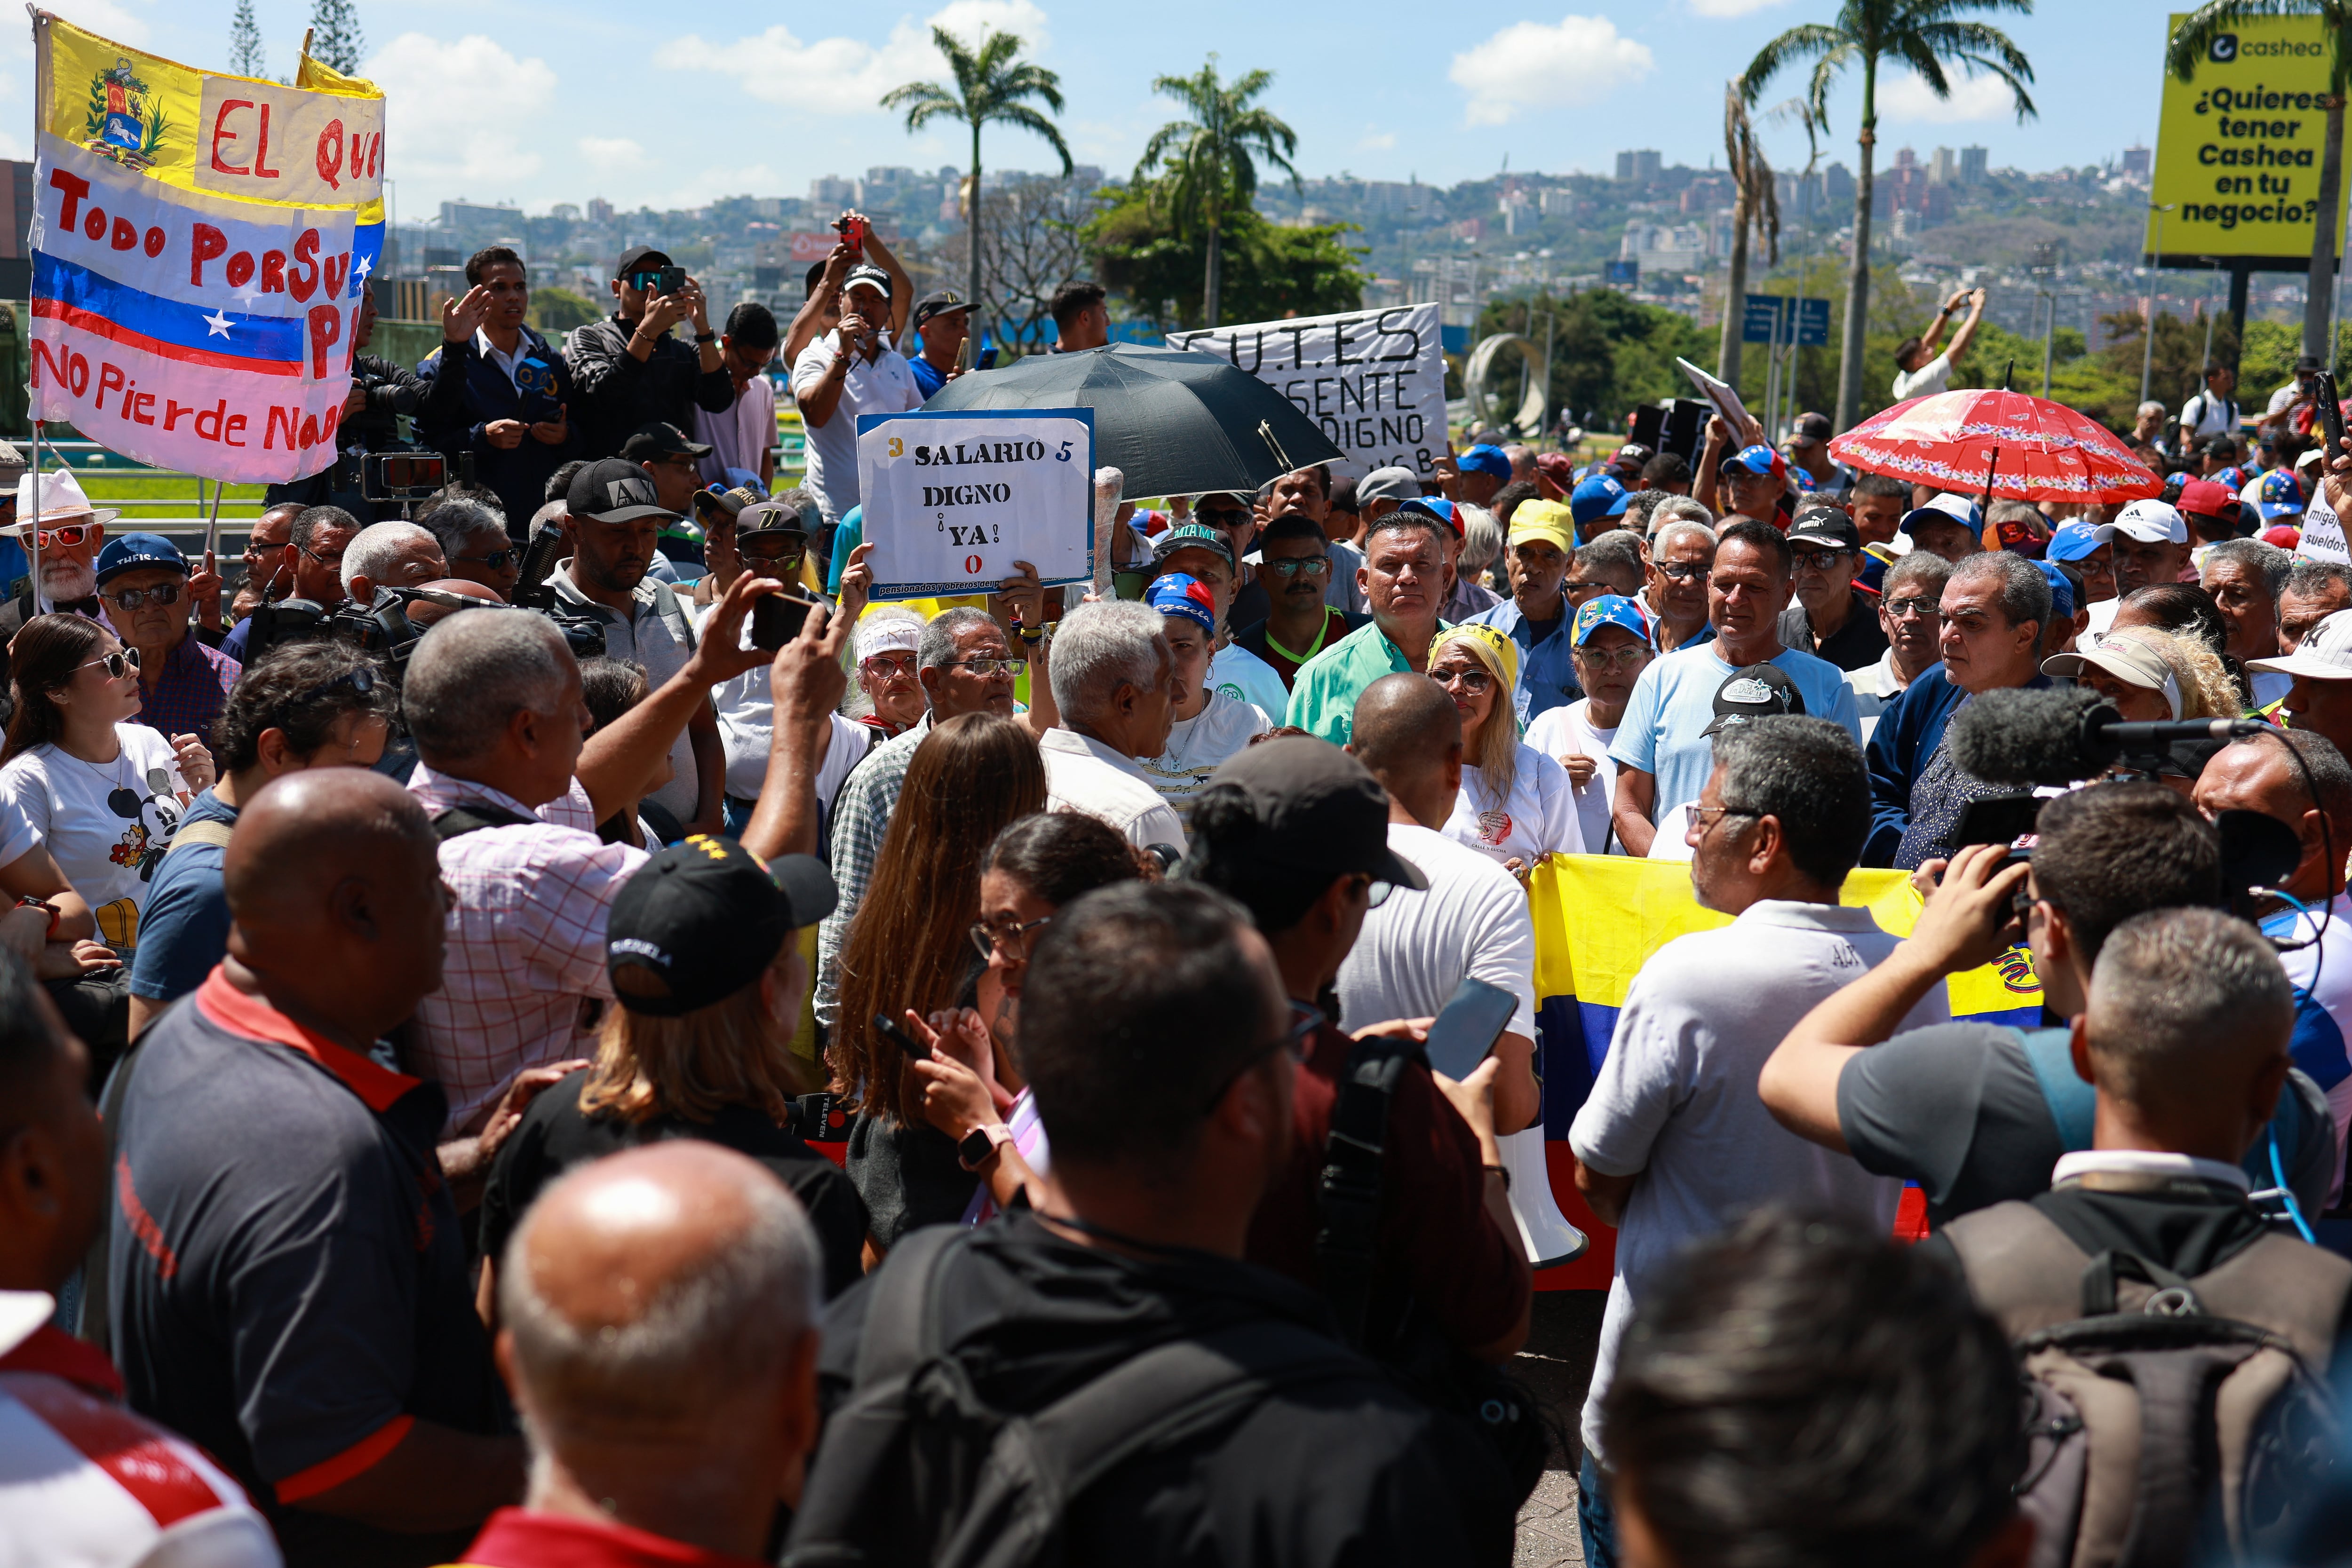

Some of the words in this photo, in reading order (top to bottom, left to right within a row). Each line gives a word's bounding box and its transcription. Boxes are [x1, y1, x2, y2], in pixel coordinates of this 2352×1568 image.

[2194, 84, 2328, 115] ¿Quieres
[2219, 118, 2301, 138] tener
[2198, 143, 2313, 167] Cashea
[2215, 178, 2253, 195] en
[2260, 173, 2290, 195] tu
[2182, 198, 2318, 230] negocio?
[888, 437, 904, 458] 3
[915, 441, 1045, 467] SALARIO
[1055, 441, 1073, 462] 5
[923, 482, 1011, 507] DIGNO
[1174, 523, 1216, 542] MIAMI
[1798, 520, 1820, 530] PUMA
[2305, 534, 2346, 552] sueldos
[879, 583, 936, 596] pensionados
[937, 584, 943, 592] y
[818, 1096, 830, 1138] TELEVEN
